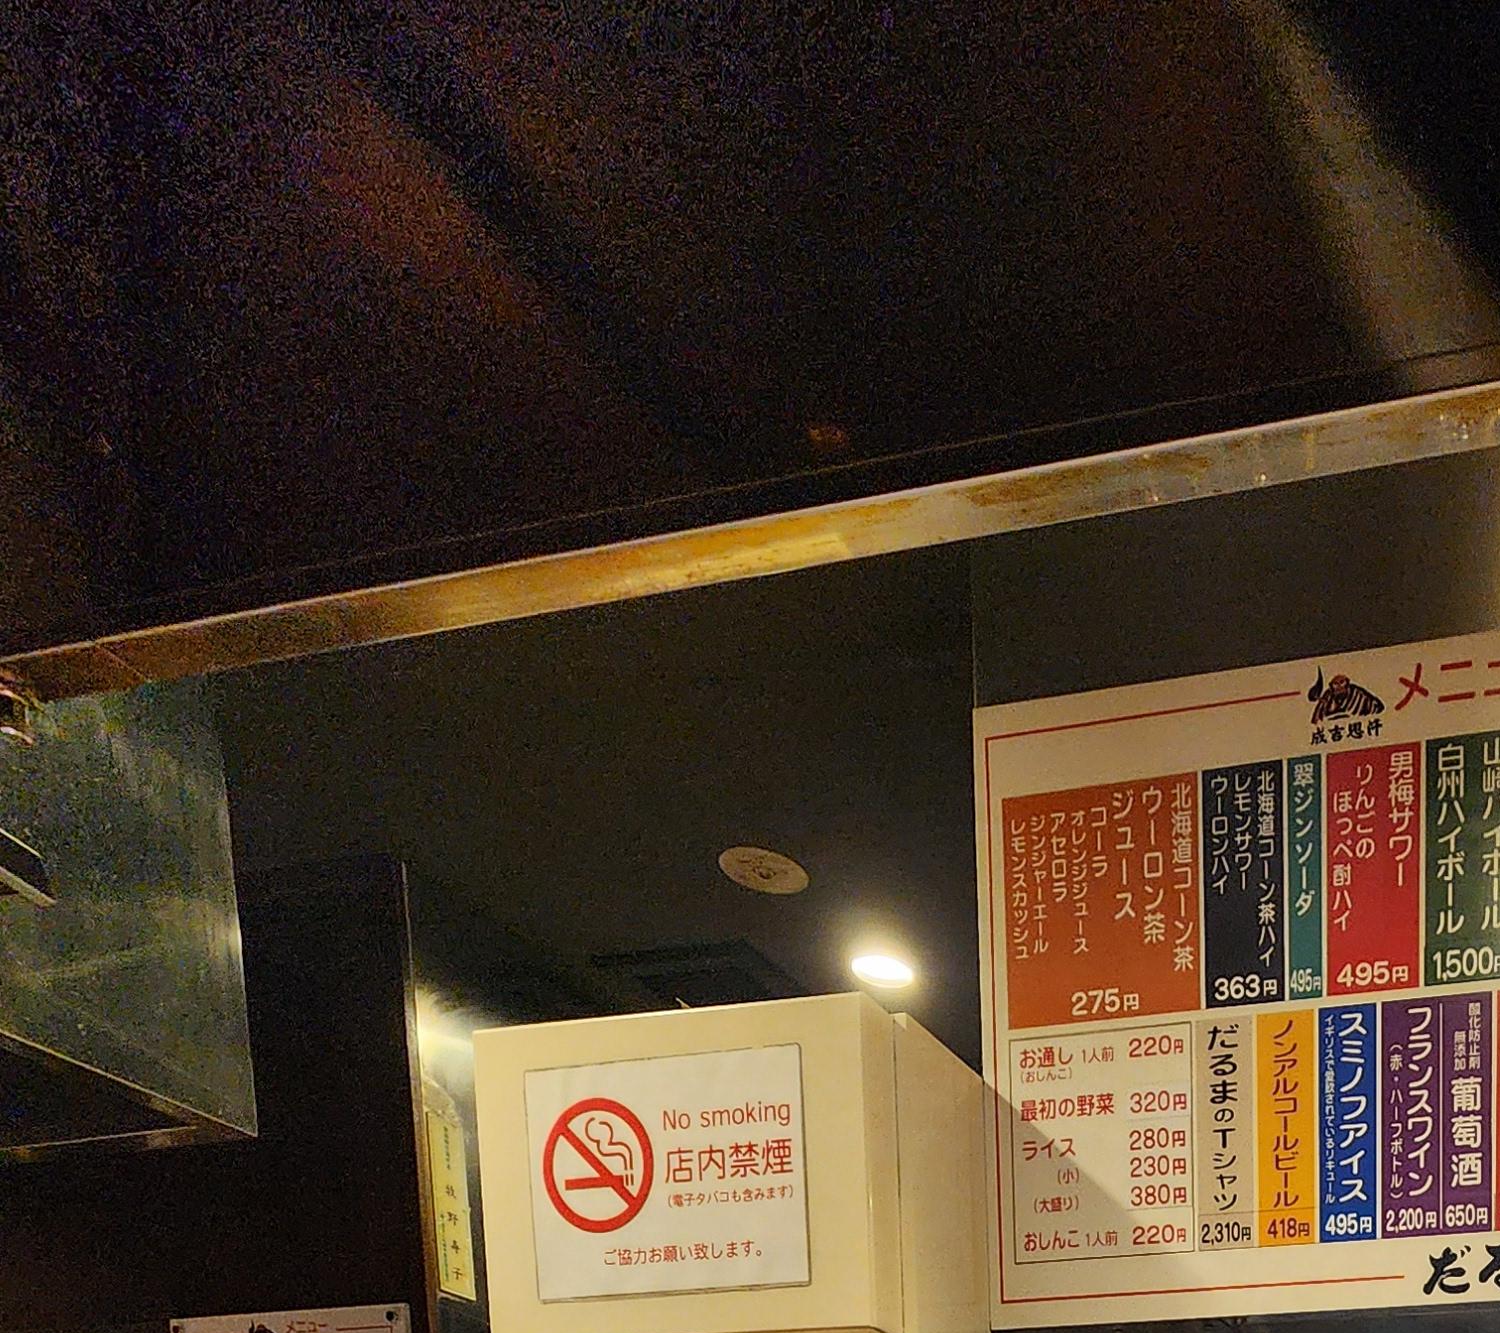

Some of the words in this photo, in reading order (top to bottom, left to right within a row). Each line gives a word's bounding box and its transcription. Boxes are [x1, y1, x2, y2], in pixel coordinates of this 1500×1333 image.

[1310, 719, 1383, 746] 成吉思汗
[1210, 774, 1231, 896] ウーロンハイ
[1233, 773, 1251, 890] レモンサワー
[1293, 763, 1316, 917] 翠ジンソーダ
[1388, 751, 1415, 887] 男梅サワー
[1436, 742, 1465, 936] 白州ハイボール
[1050, 812, 1069, 903] アセロラ
[1091, 806, 1108, 878] コーラ
[1112, 790, 1136, 921] ジュース
[1030, 814, 1050, 954] ジンジャーエール
[1071, 809, 1089, 955] オレンジジュース
[1142, 786, 1166, 944] ウーロン茶
[1171, 782, 1195, 972] 北海道コーン茶
[1256, 770, 1280, 968] 北海道コーン茶ハイ
[1010, 819, 1030, 961] レモンスカッシュ
[1213, 974, 1278, 1000] 363円
[1289, 968, 1322, 993] 495円
[1336, 961, 1409, 988] 495円
[1071, 990, 1140, 1017] 275円
[1018, 1046, 1073, 1070] お通し
[1081, 1045, 1115, 1064] 1人前
[1128, 1035, 1185, 1059] 220円
[1454, 1030, 1466, 1071] 無添加
[1467, 1002, 1481, 1070] 酸化防止剤
[1019, 1067, 1073, 1085] (おしんこ)
[662, 1109, 692, 1131] No
[699, 1101, 792, 1129] smoking
[1020, 1093, 1115, 1122] 最初の野菜
[1129, 1089, 1188, 1114] 320円
[1207, 1022, 1239, 1212] だるまのTシャツ
[1272, 1019, 1299, 1209] ノンアルコールビール
[1338, 1012, 1368, 1203] スミノフアイス
[1406, 1007, 1433, 1197] フランスワイン
[1021, 1138, 1077, 1161] ライス
[1129, 1127, 1187, 1152] 280円
[1450, 1076, 1483, 1188] 葡萄酒
[664, 1137, 794, 1185] 店内禁煙
[1057, 1168, 1081, 1185] (小)
[1129, 1155, 1187, 1179] 230円
[667, 1184, 794, 1210] (電子タバコも含みます)
[1033, 1195, 1081, 1214] (大盛り)
[1129, 1184, 1188, 1207] 380円
[1445, 1204, 1489, 1229] 650円
[1024, 1229, 1080, 1251] おしんこ
[1085, 1230, 1118, 1247] 1人前
[1132, 1224, 1187, 1245] 220円
[1201, 1221, 1252, 1244] 2,310円
[1267, 1217, 1310, 1239] 418円
[1325, 1212, 1373, 1236] 495円
[1386, 1207, 1437, 1234] 2,200円
[603, 1239, 763, 1267] ご協力お願い致します。
